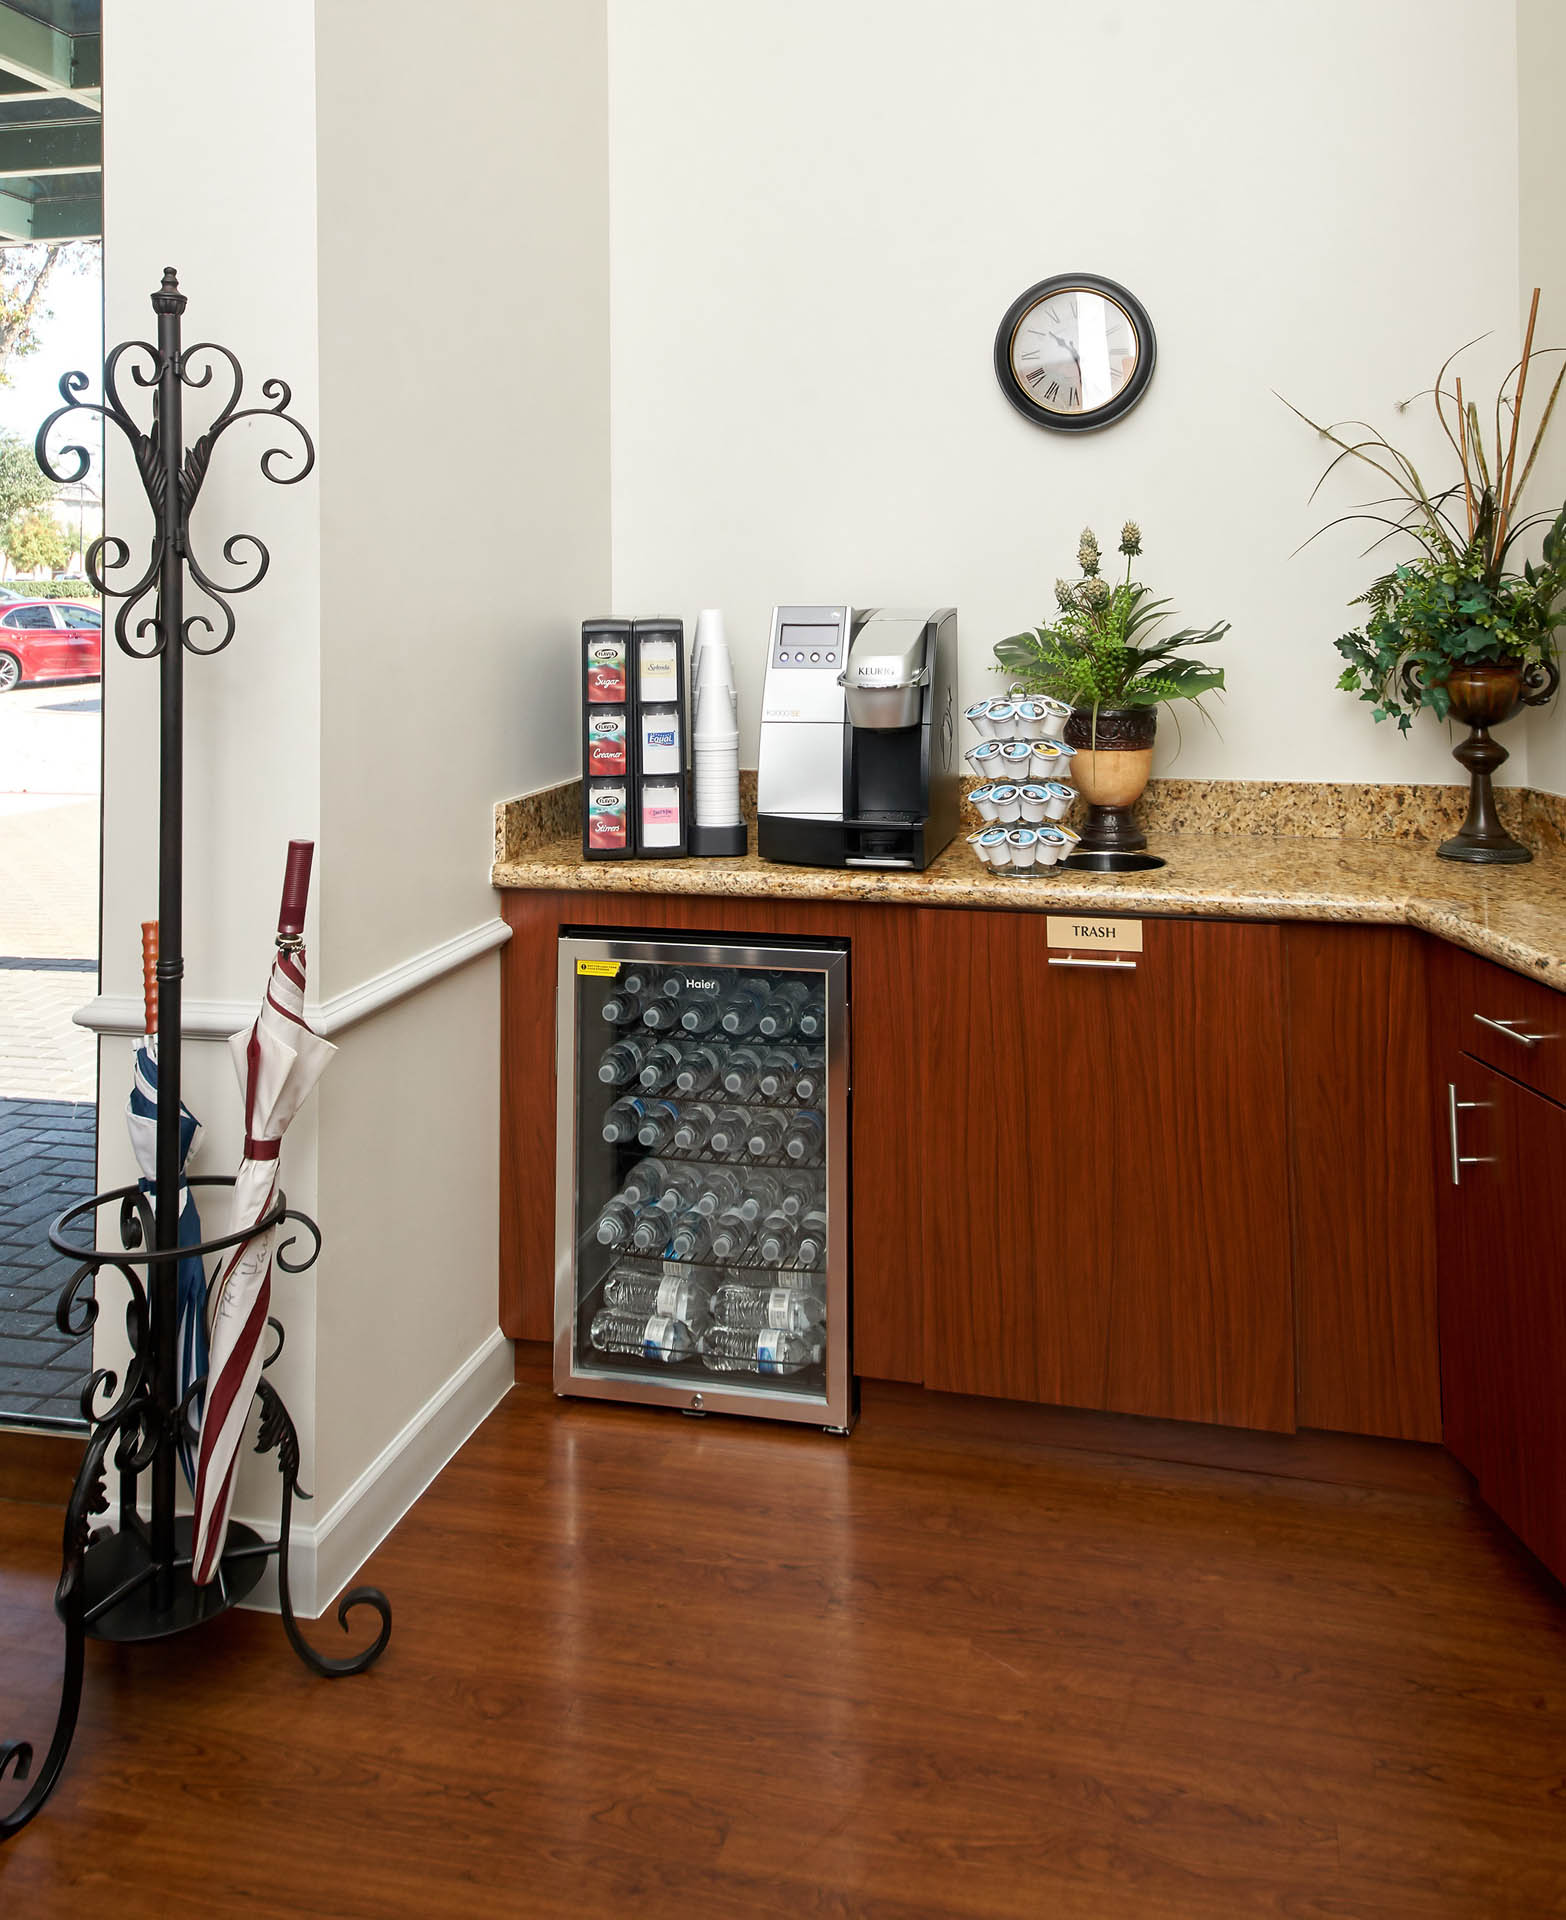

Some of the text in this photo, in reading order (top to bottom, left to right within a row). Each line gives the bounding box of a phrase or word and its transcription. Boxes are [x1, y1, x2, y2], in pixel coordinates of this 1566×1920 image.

[594, 674, 620, 689] Sugar
[649, 734, 673, 744] Equal
[593, 748, 623, 759] Creamer
[1071, 925, 1116, 938] TRASH
[686, 979, 715, 989] Haier
